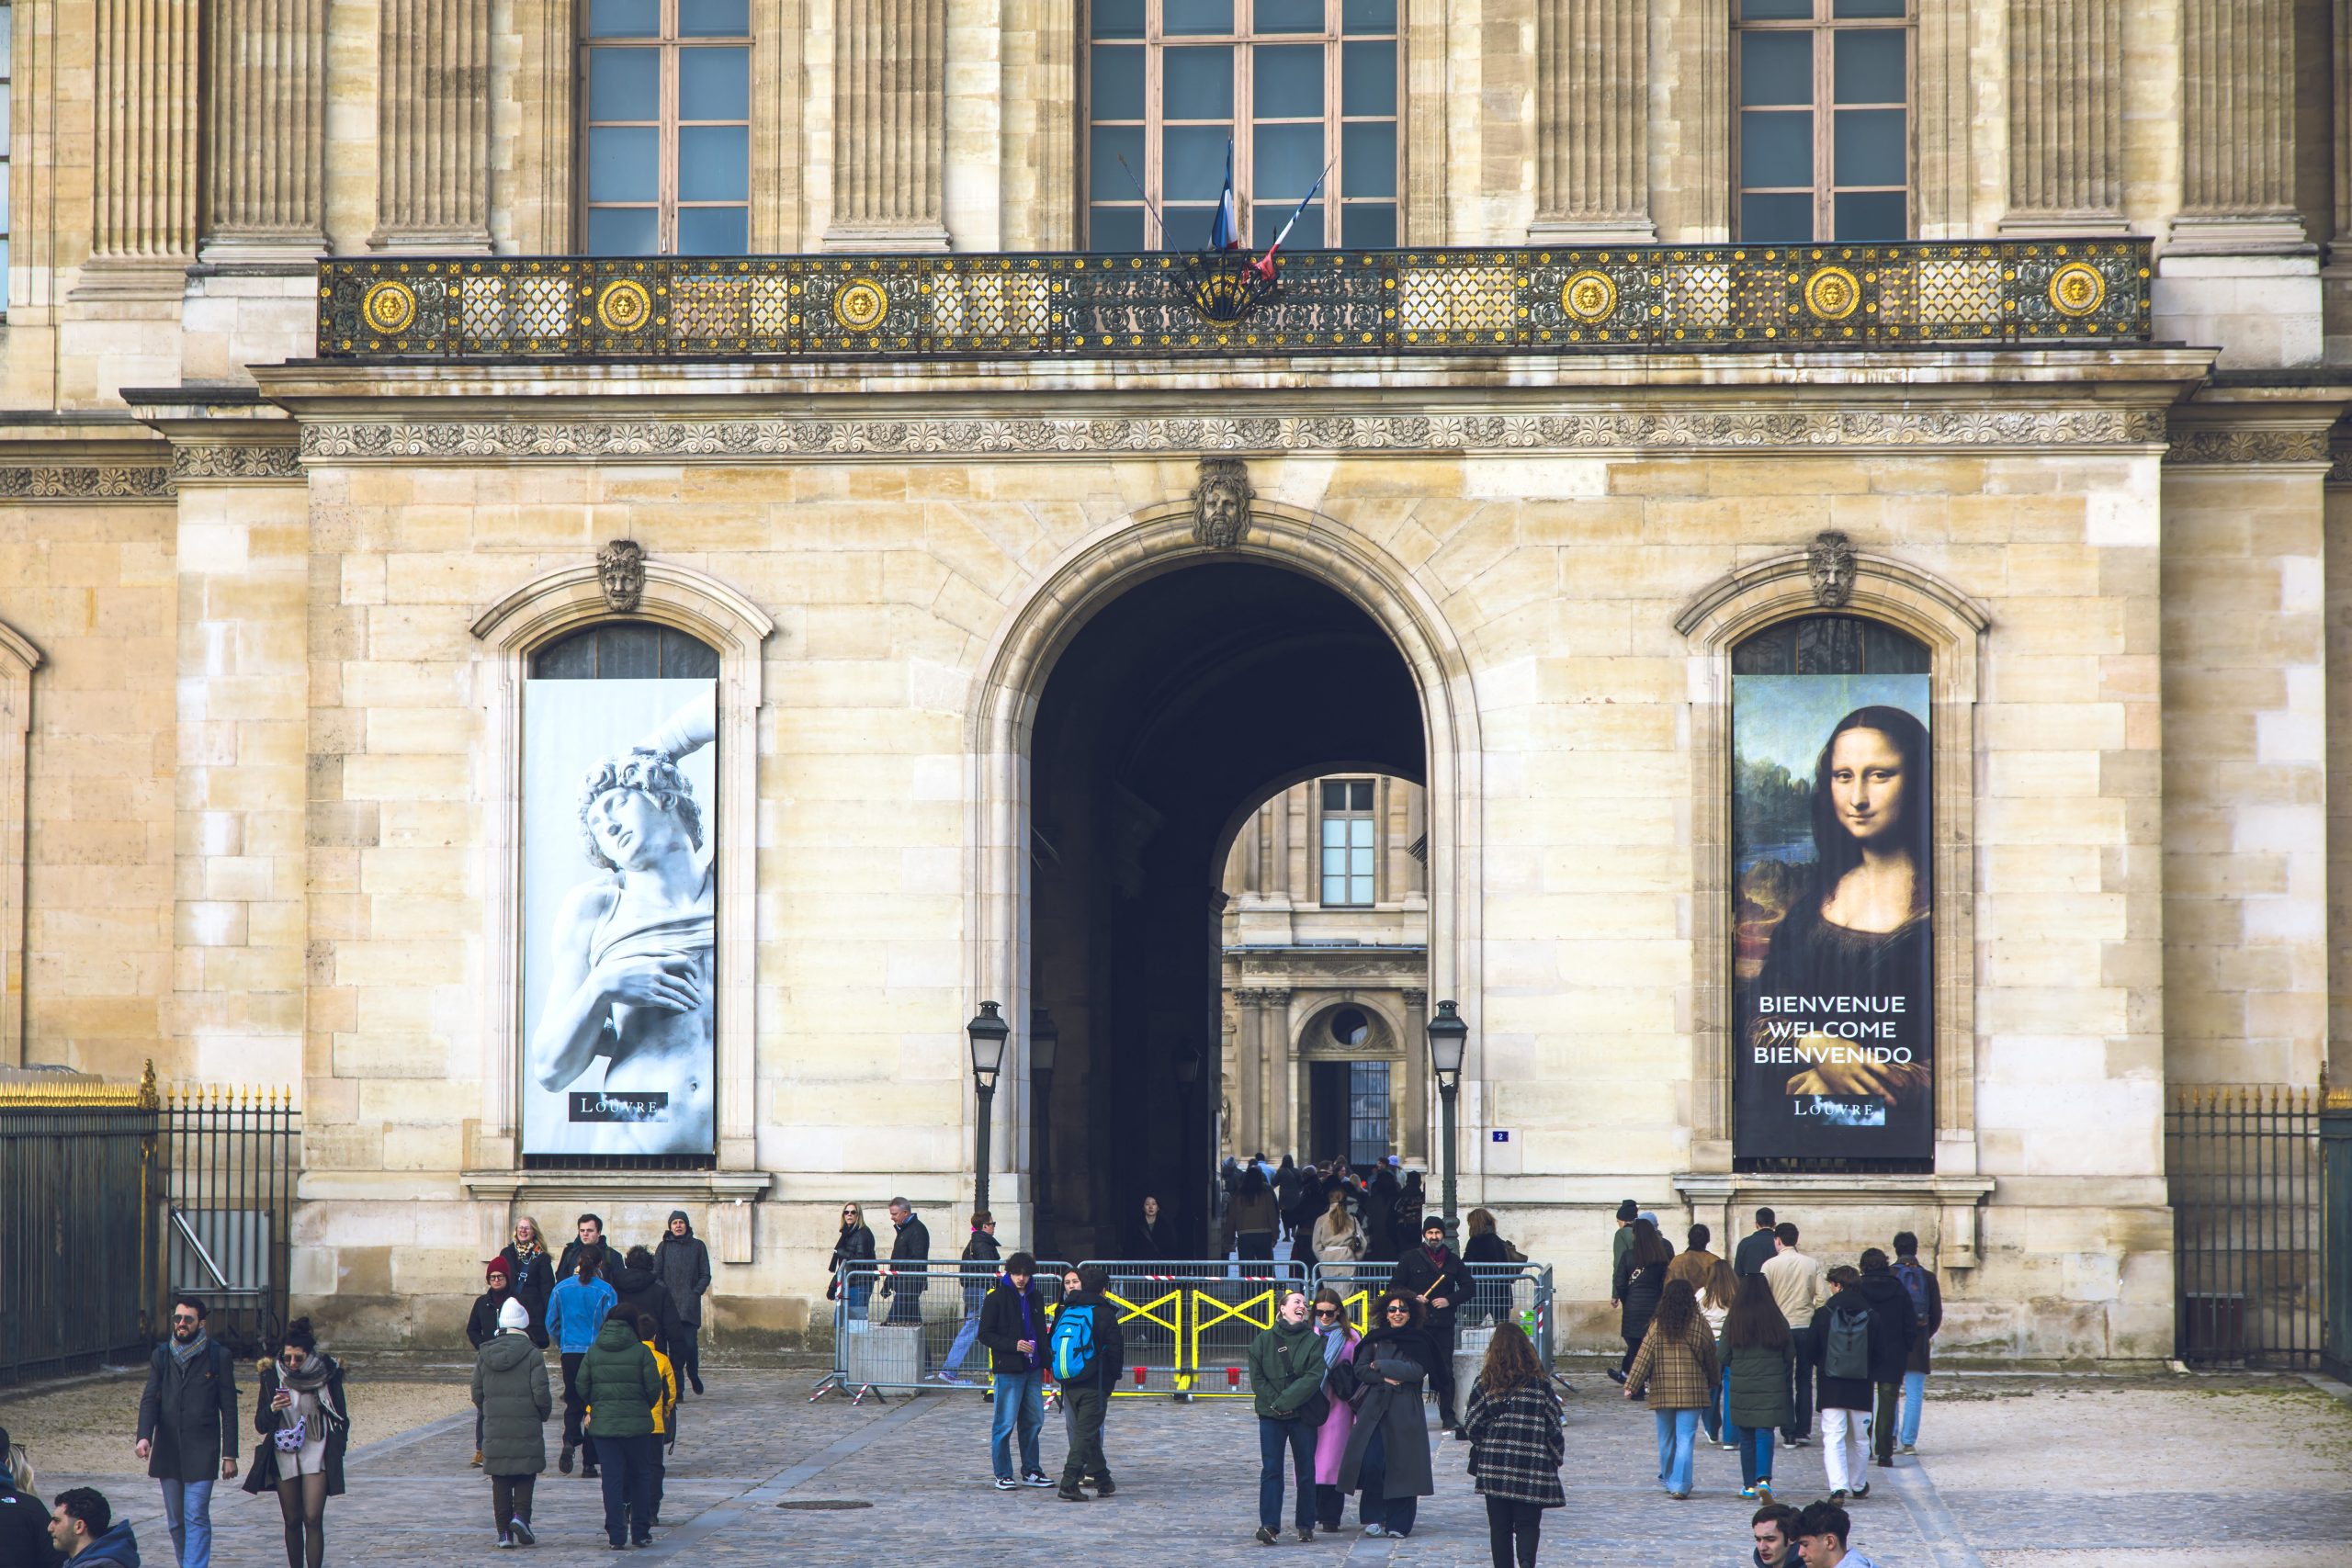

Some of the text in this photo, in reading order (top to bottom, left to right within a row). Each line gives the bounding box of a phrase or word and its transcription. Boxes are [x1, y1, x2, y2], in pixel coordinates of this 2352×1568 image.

[1759, 996, 1905, 1012] BIENVENUE
[1769, 1021, 1896, 1038] WELCOME
[1754, 1047, 1912, 1064] BIENVENIDO
[581, 1098, 657, 1112] LOUVRE
[1794, 1100, 1873, 1115] LOUVRE
